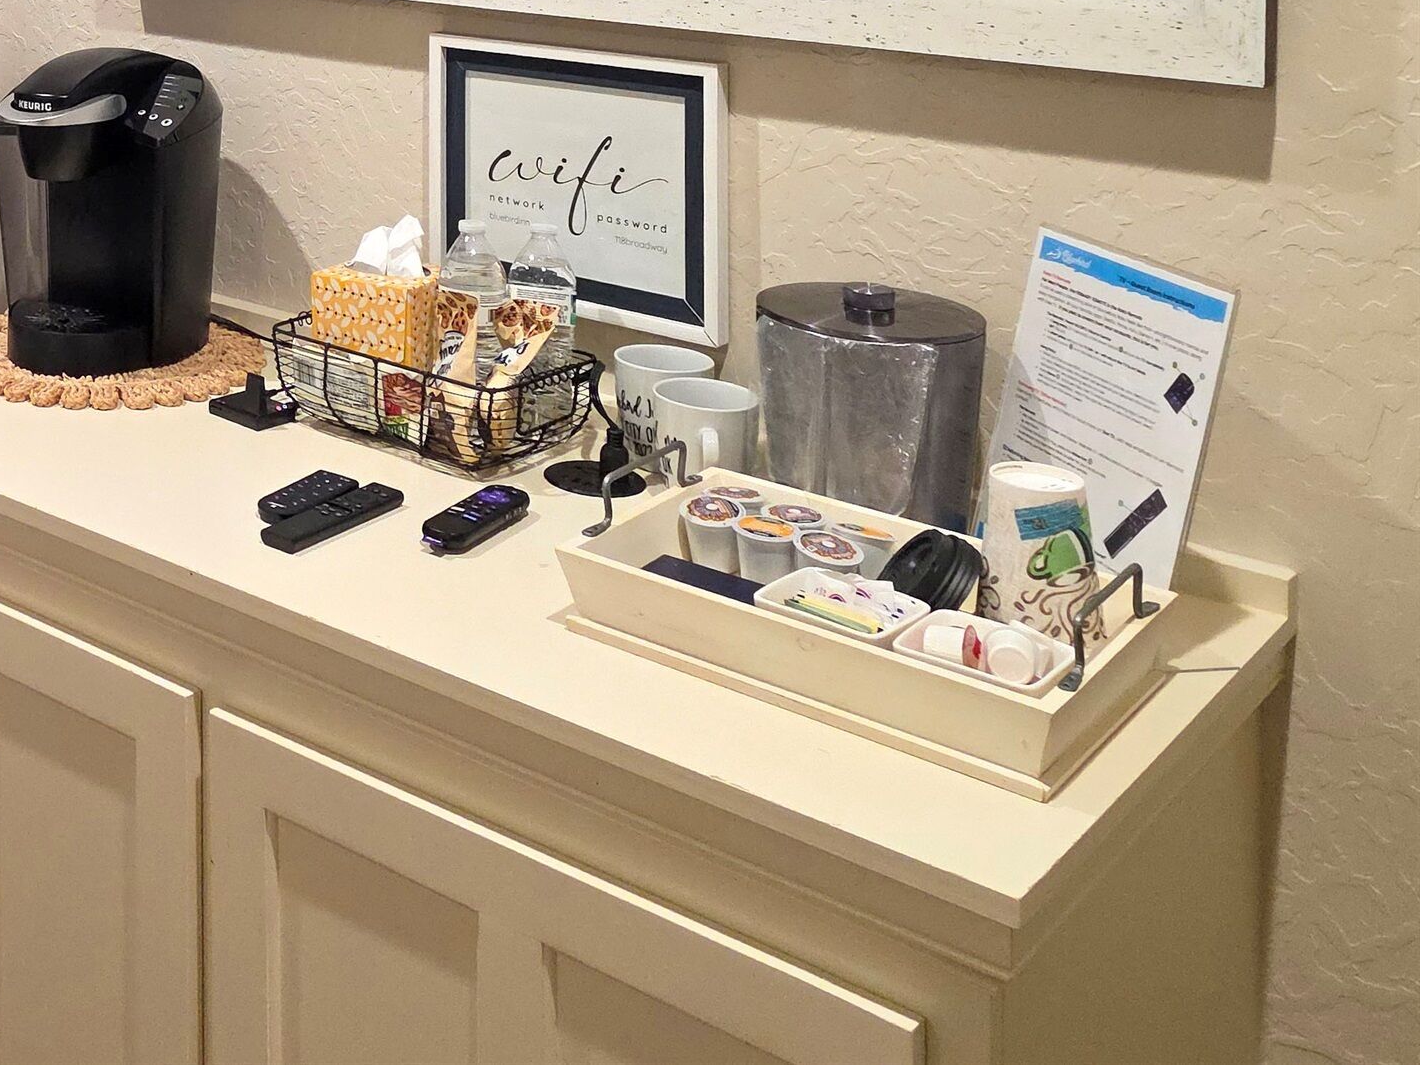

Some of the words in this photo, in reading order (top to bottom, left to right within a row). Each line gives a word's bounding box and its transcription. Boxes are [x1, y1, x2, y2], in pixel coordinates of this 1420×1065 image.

[18, 99, 52, 112] KEURIG
[488, 135, 670, 236] wifi
[489, 193, 545, 211] network
[596, 213, 668, 234] password
